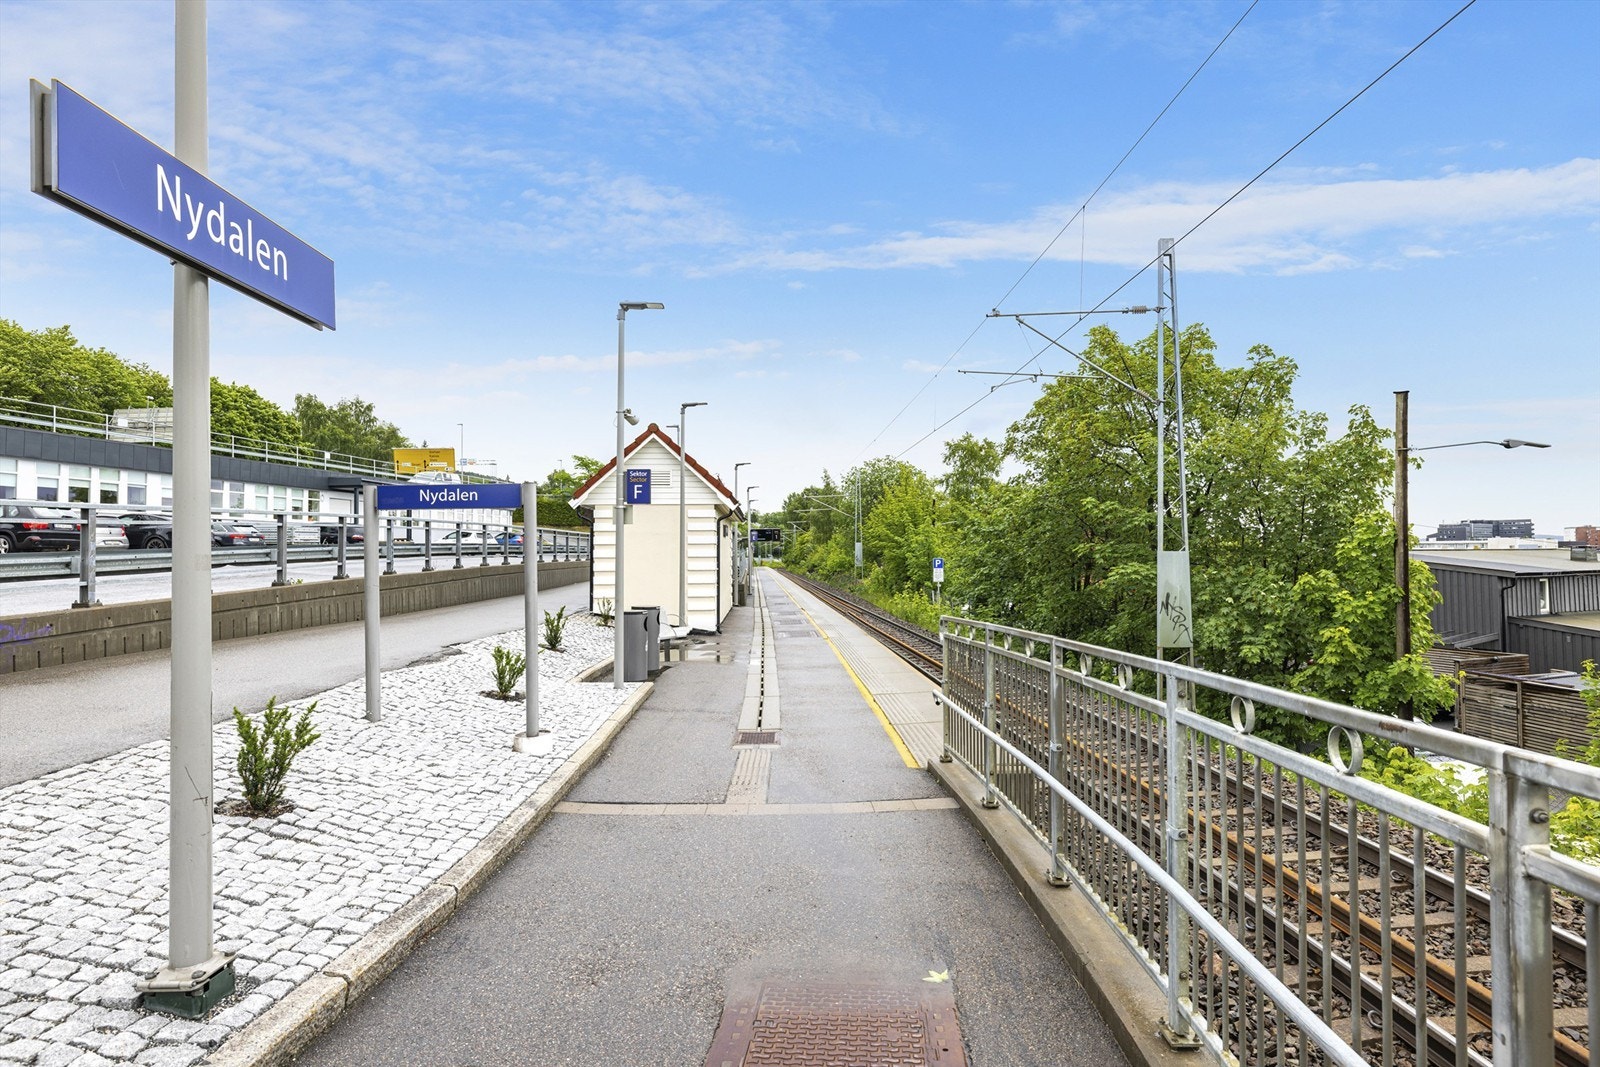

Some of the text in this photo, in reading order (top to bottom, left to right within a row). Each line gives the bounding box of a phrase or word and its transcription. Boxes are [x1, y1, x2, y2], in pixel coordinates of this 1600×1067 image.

[157, 163, 288, 281] Nydalen
[419, 488, 478, 504] Nydalen
[634, 485, 643, 499] F
[935, 560, 942, 568] P
